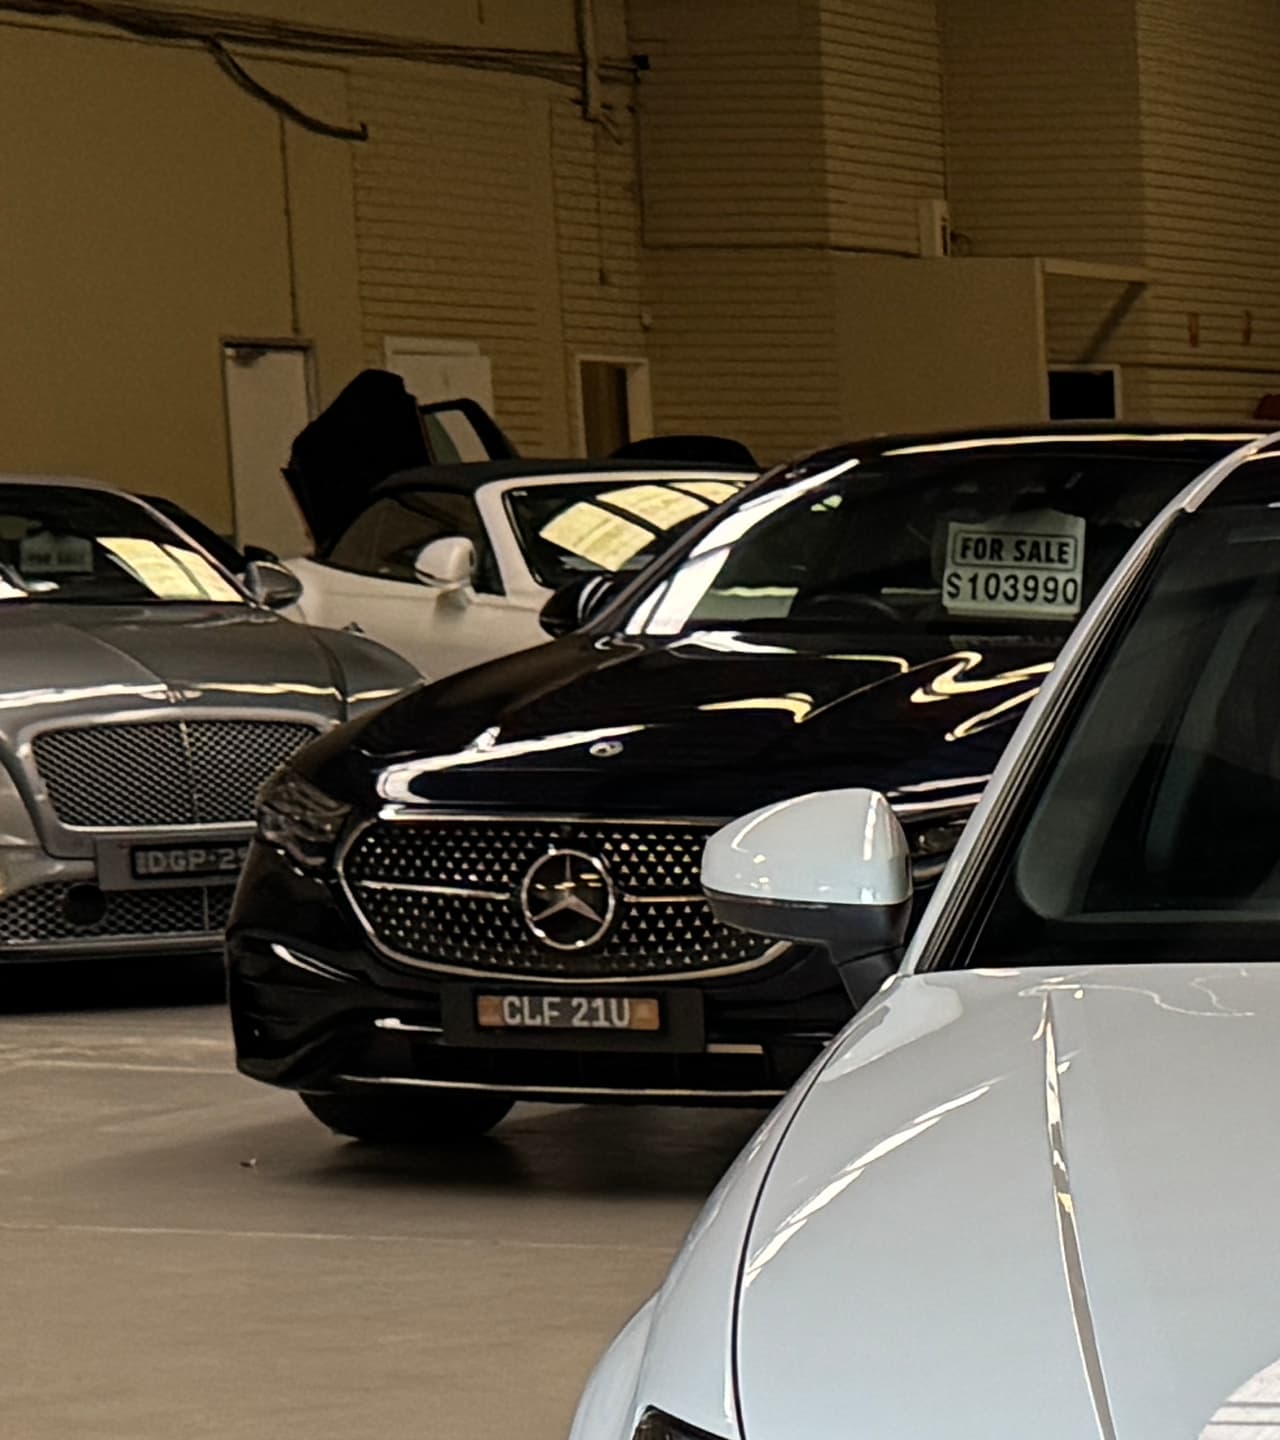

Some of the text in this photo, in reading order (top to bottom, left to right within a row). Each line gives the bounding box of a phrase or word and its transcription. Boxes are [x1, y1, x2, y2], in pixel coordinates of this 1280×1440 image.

[960, 536, 1070, 565] FOR SALE
[947, 571, 1078, 605] $103990
[503, 995, 631, 1028] CLF 21U
